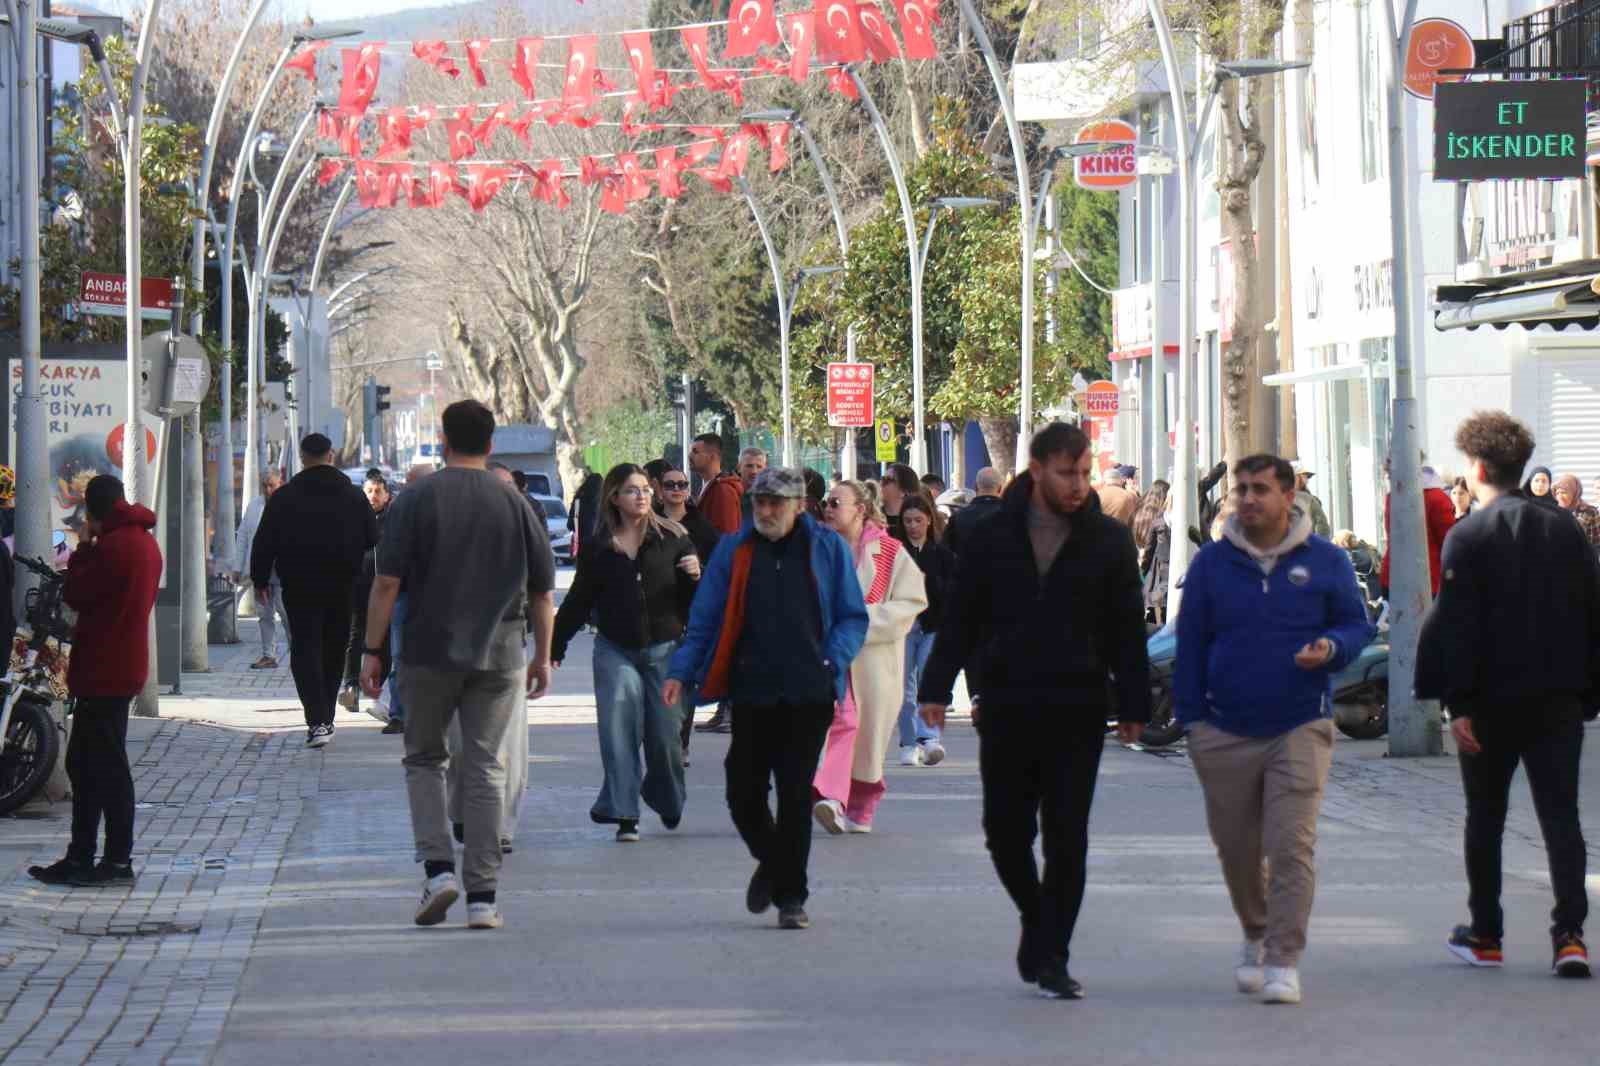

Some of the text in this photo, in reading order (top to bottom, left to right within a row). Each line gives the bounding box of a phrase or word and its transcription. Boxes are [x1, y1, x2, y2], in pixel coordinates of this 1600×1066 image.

[1498, 102, 1529, 124] ET
[1447, 132, 1577, 159] İSKENDER
[1080, 156, 1136, 174] KING
[12, 364, 101, 380] SKARYA
[13, 383, 75, 399] CUK
[1088, 392, 1119, 401] BURGER
[1088, 400, 1119, 410] KING
